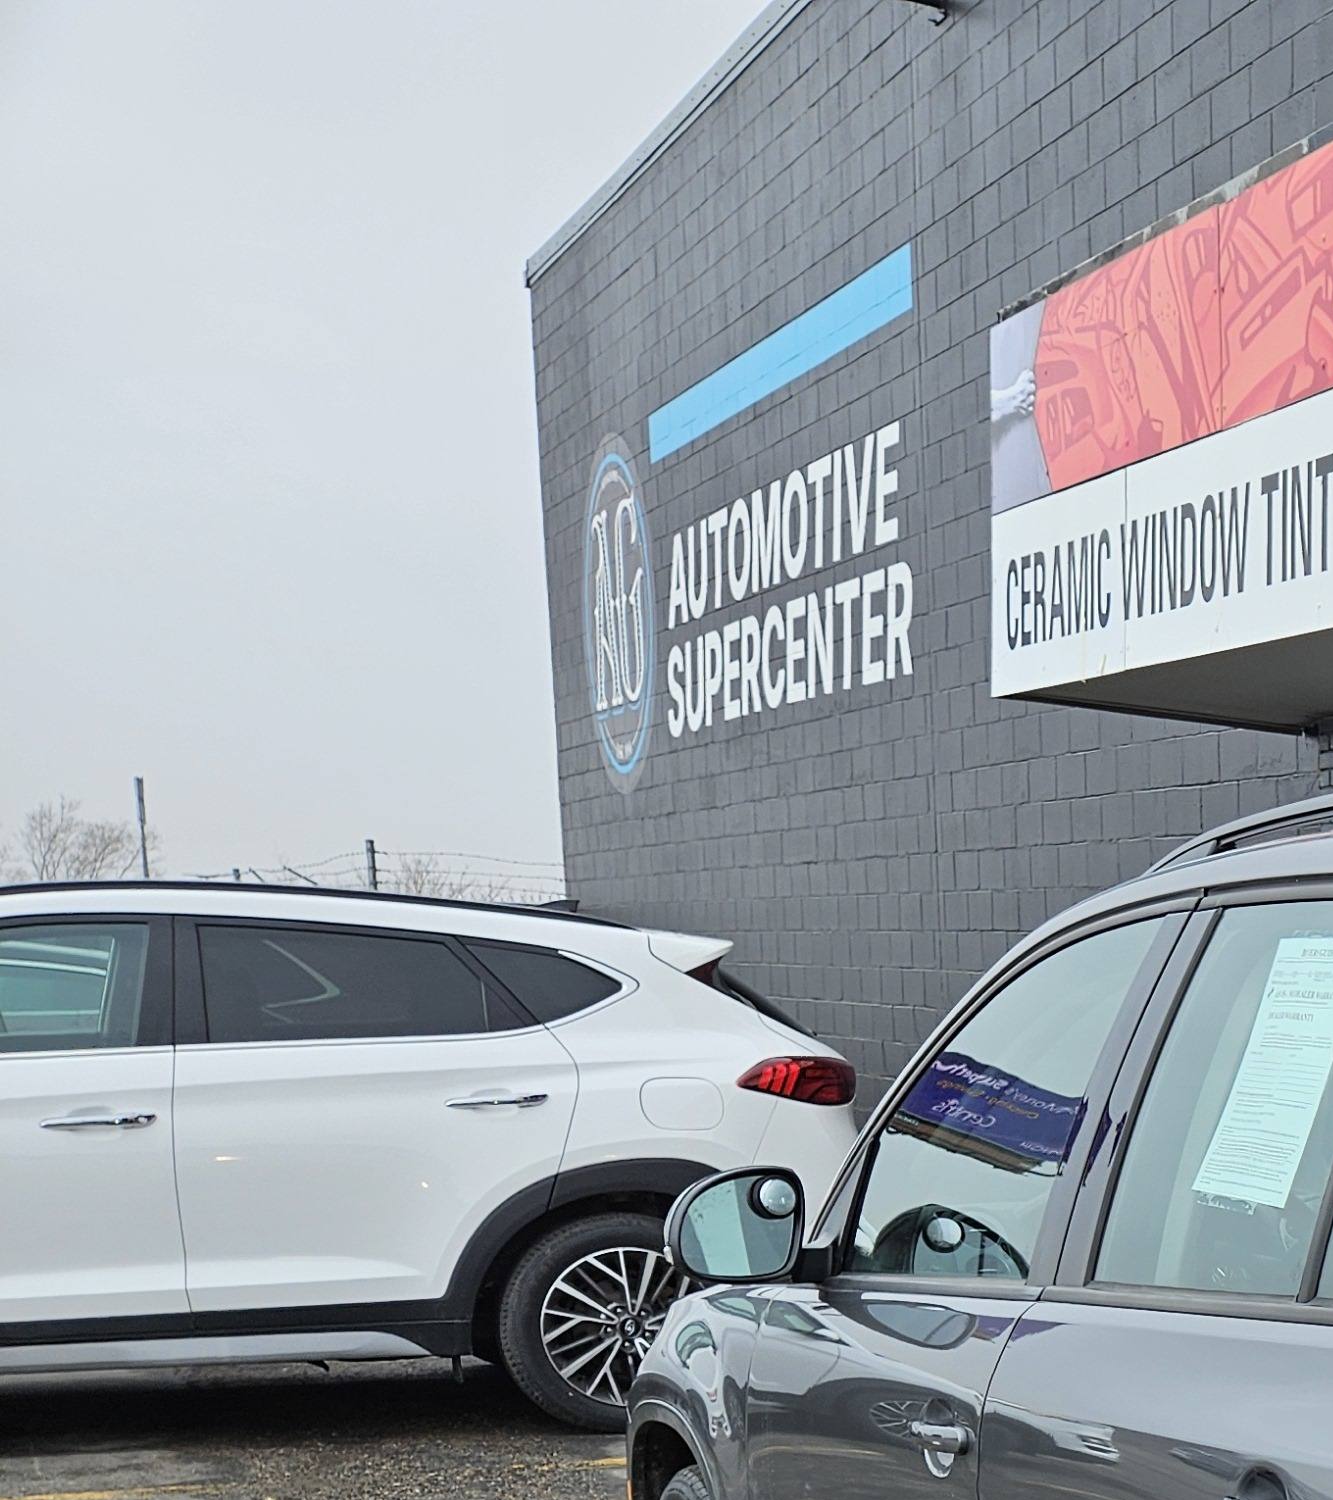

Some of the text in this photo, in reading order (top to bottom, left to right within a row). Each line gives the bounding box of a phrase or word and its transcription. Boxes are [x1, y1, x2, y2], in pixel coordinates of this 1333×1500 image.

[667, 420, 900, 630] AUTOMOTIVE
[1007, 520, 1110, 650] CERAMIC
[1121, 481, 1250, 622] WINDOW
[667, 560, 914, 738] SUPERCENTER
